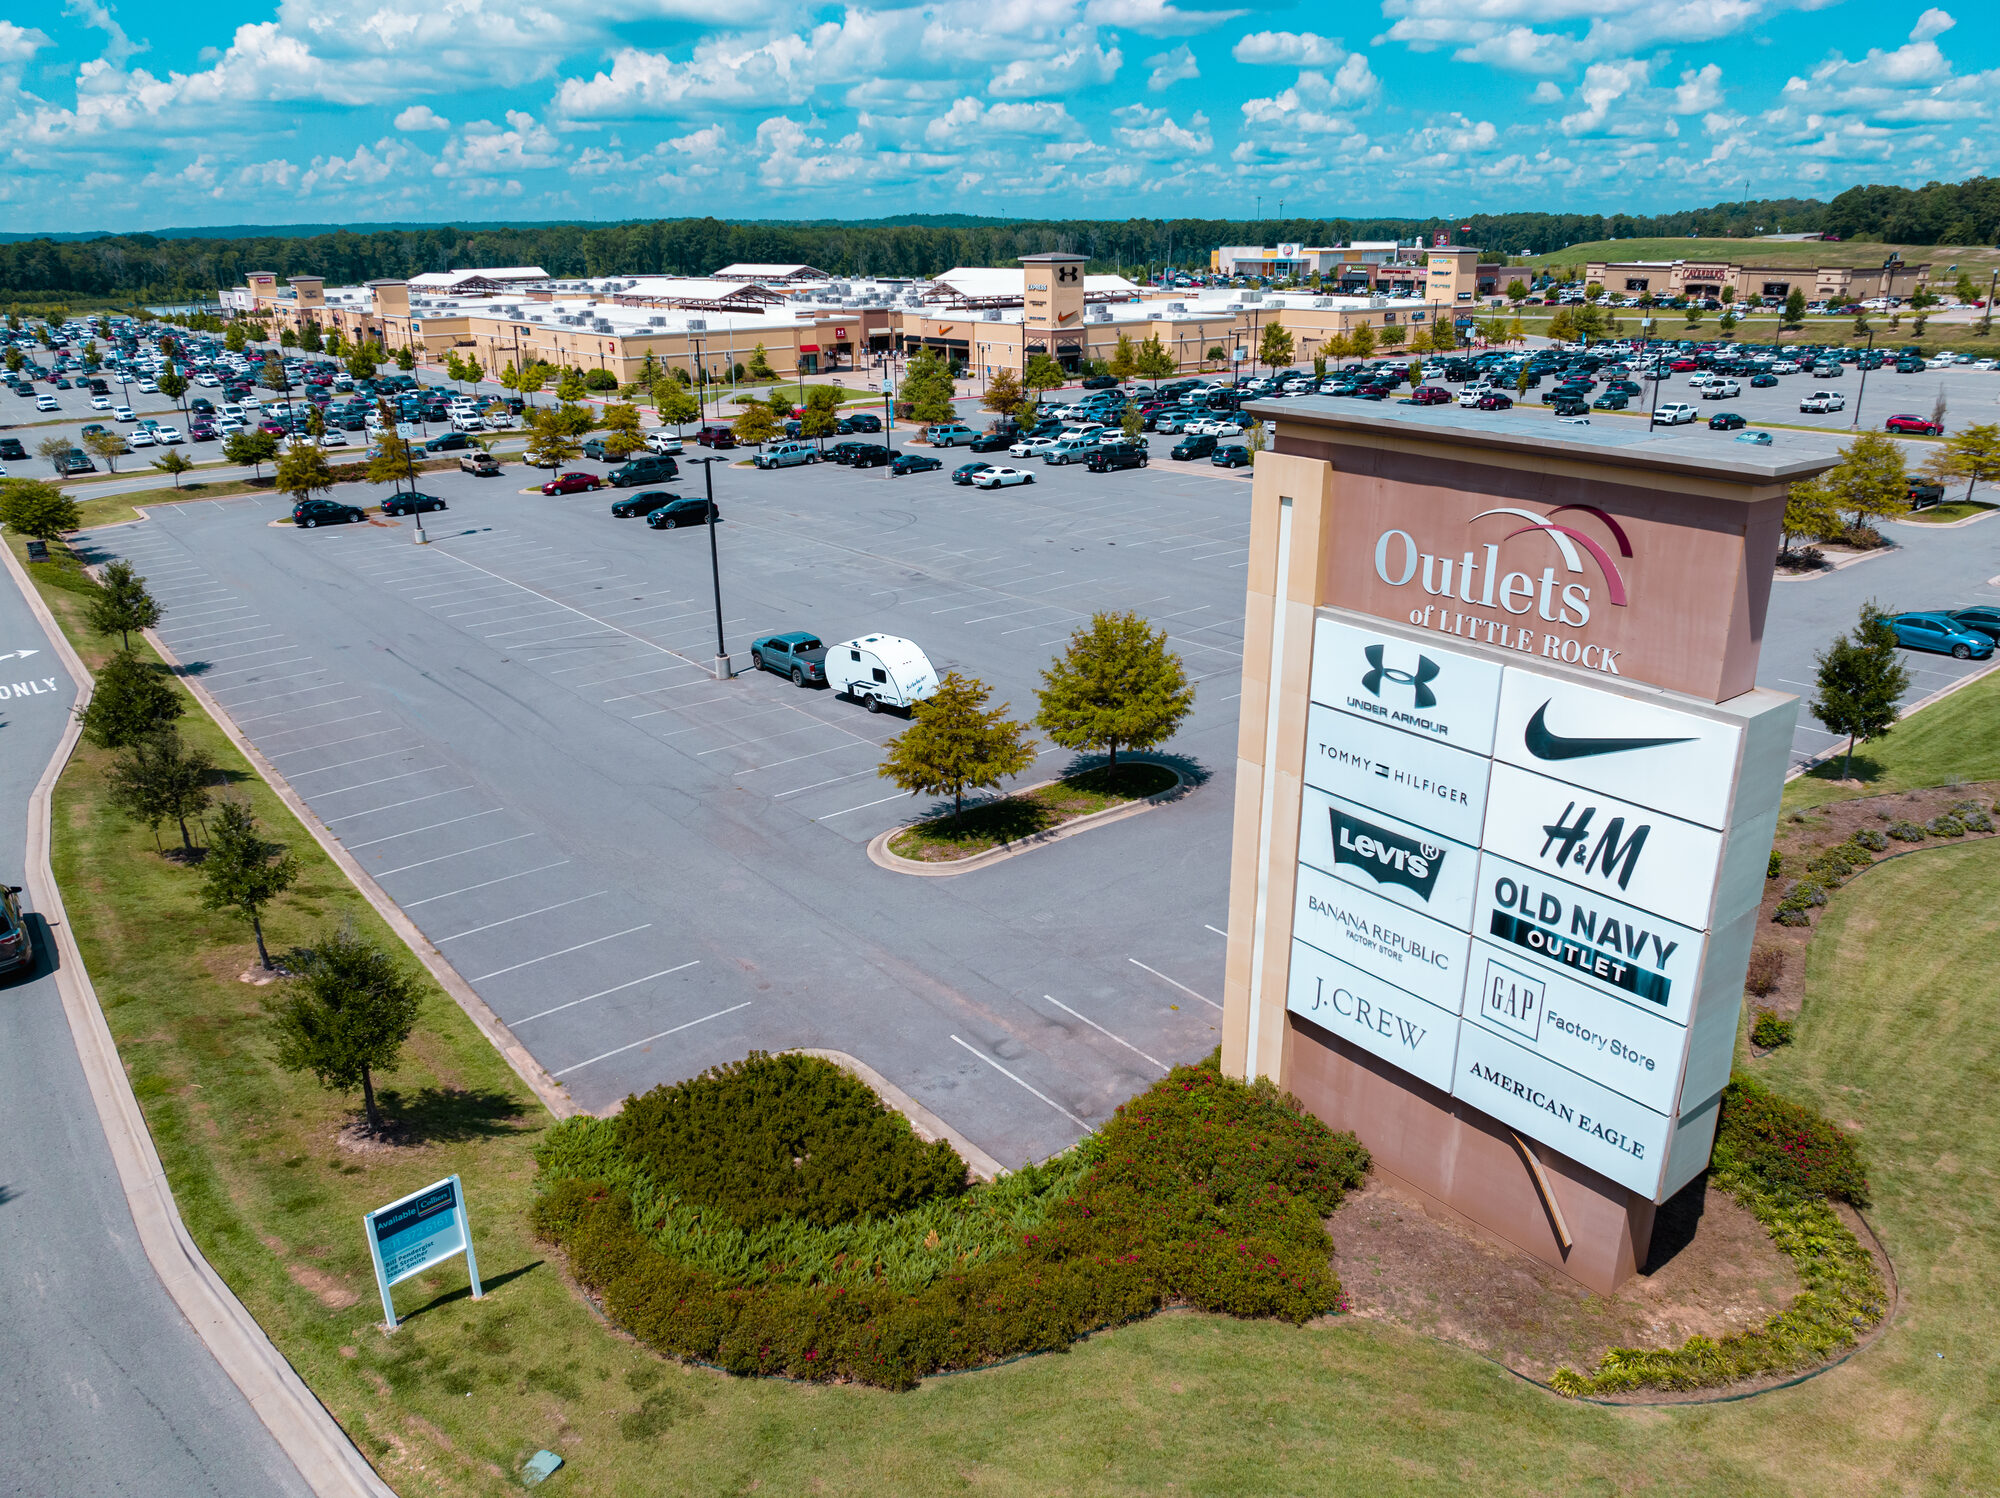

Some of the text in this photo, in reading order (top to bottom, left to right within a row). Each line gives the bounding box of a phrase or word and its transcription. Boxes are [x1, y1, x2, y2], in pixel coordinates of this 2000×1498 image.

[1375, 529, 1591, 627] Outlets
[1409, 604, 1622, 675] of LITTLE ROCK
[0, 677, 58, 700] ONLY
[1347, 696, 1448, 735] UNDER ARMOUR
[1319, 743, 1468, 806] TOMMY HILFIGER
[1540, 801, 1651, 891] H&M
[1308, 896, 1449, 970] BANANA REPUBLIC
[1345, 930, 1403, 962] FACTORY STORE
[1494, 877, 1679, 971] OLD NAVY
[1527, 930, 1627, 982] OUTLET
[1311, 976, 1427, 1051] J.CREW
[1491, 976, 1534, 1021] GAP
[1547, 1010, 1656, 1071] Factory Store
[1469, 1061, 1646, 1160] AMERICAN EAGLE
[377, 1208, 416, 1231] Available
[420, 1193, 448, 1208] Colliers
[385, 1258, 397, 1268] Bill
[406, 1256, 426, 1269] Smith
